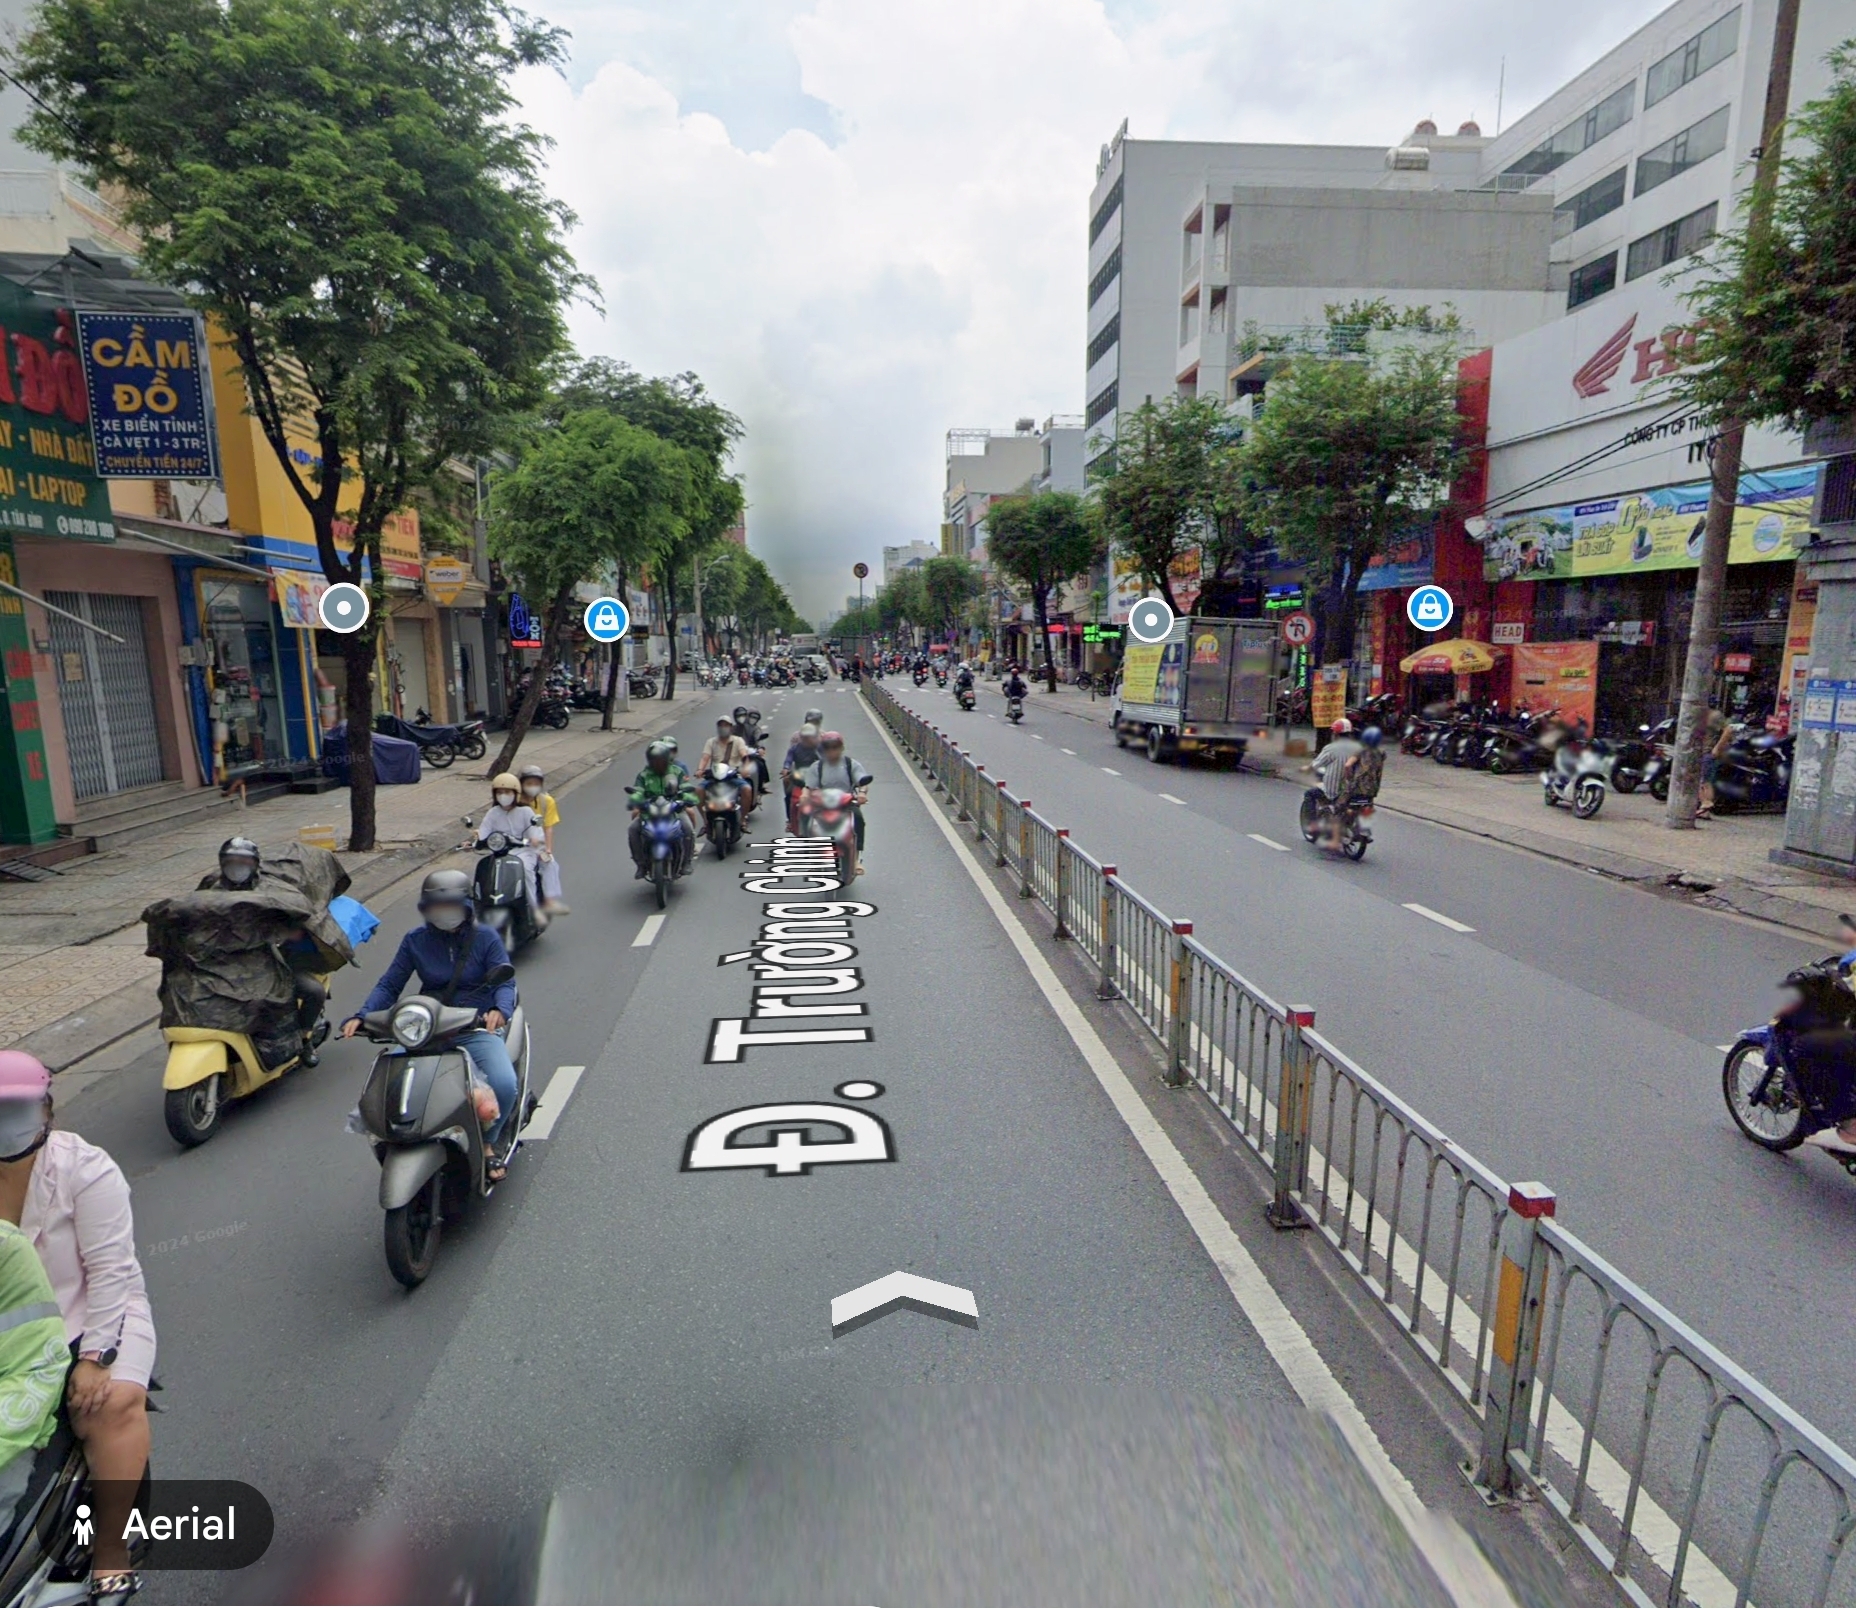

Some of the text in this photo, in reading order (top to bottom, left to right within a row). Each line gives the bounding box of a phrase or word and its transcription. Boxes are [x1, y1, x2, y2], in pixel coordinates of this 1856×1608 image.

[91, 323, 191, 369] CẦM
[112, 369, 178, 414] ĐỒ
[102, 413, 197, 433] XE BIỂN TỈNH
[29, 427, 65, 460] NHÀ
[103, 434, 122, 448] CÀ
[154, 437, 160, 448] 1
[171, 437, 180, 448] 3
[182, 437, 200, 449] TR
[105, 451, 151, 468] CHUYỂN
[27, 472, 87, 507] LAPTOP
[1494, 625, 1521, 637] HEAD
[0, 1336, 70, 1430] Grab
